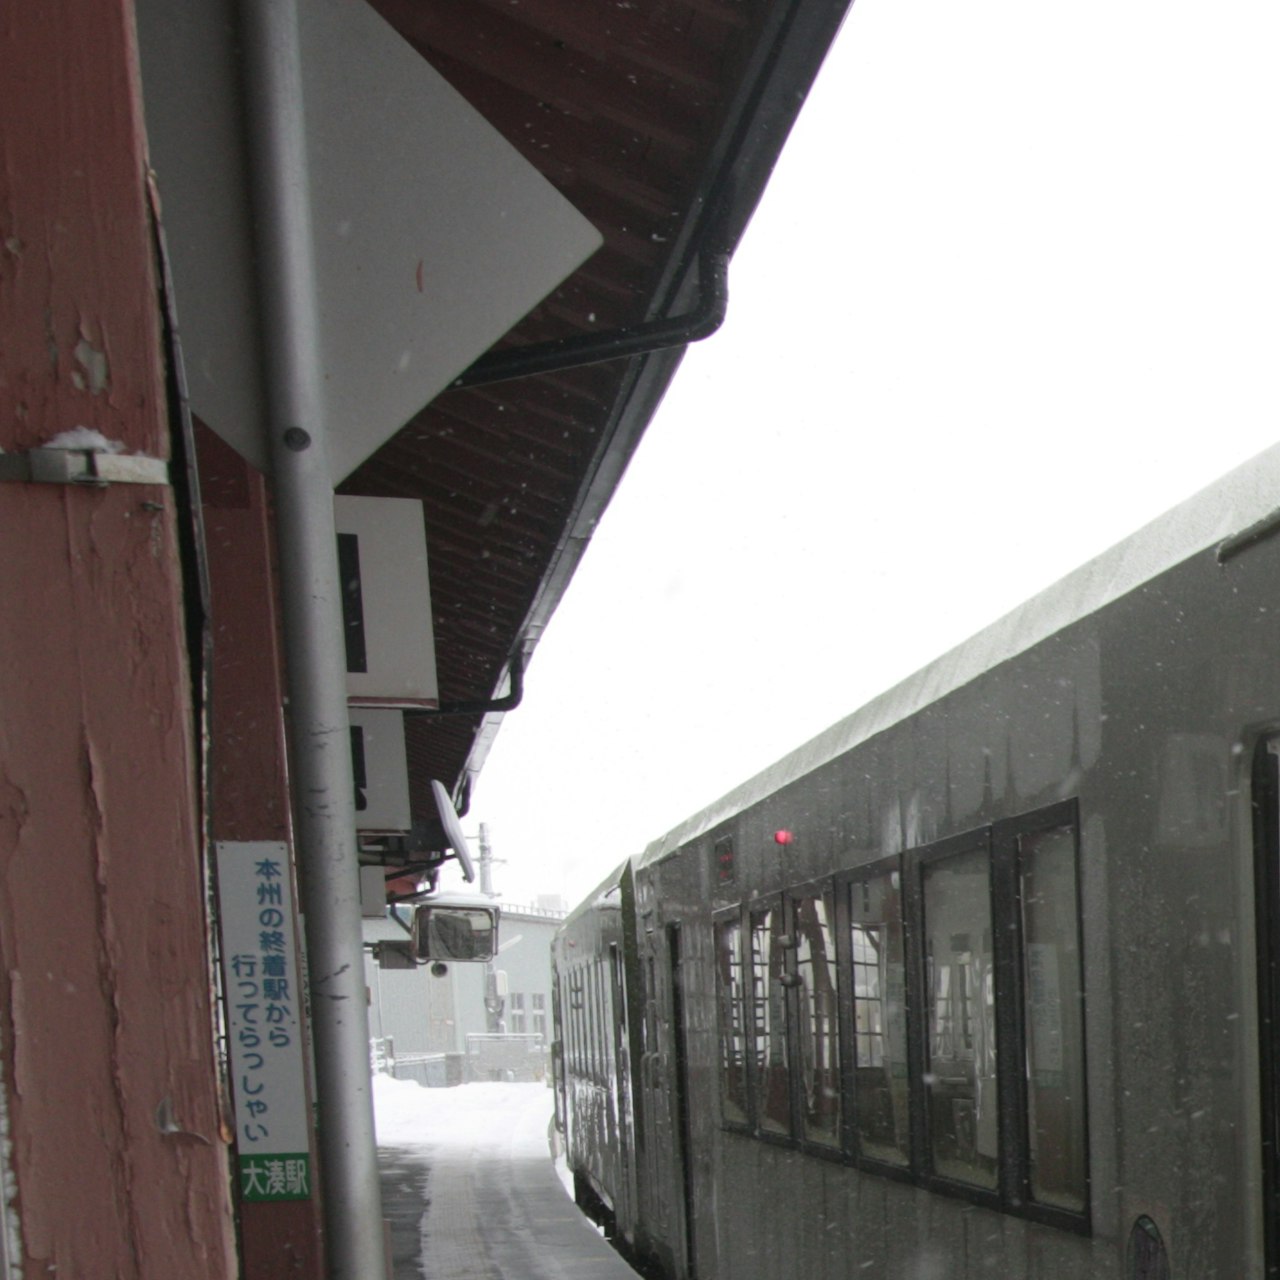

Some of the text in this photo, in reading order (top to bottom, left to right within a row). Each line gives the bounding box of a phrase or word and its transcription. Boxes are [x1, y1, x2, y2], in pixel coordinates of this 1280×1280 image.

[254, 858, 291, 1048] 本州の終着駅から
[242, 1158, 308, 1197] 大湊駅
